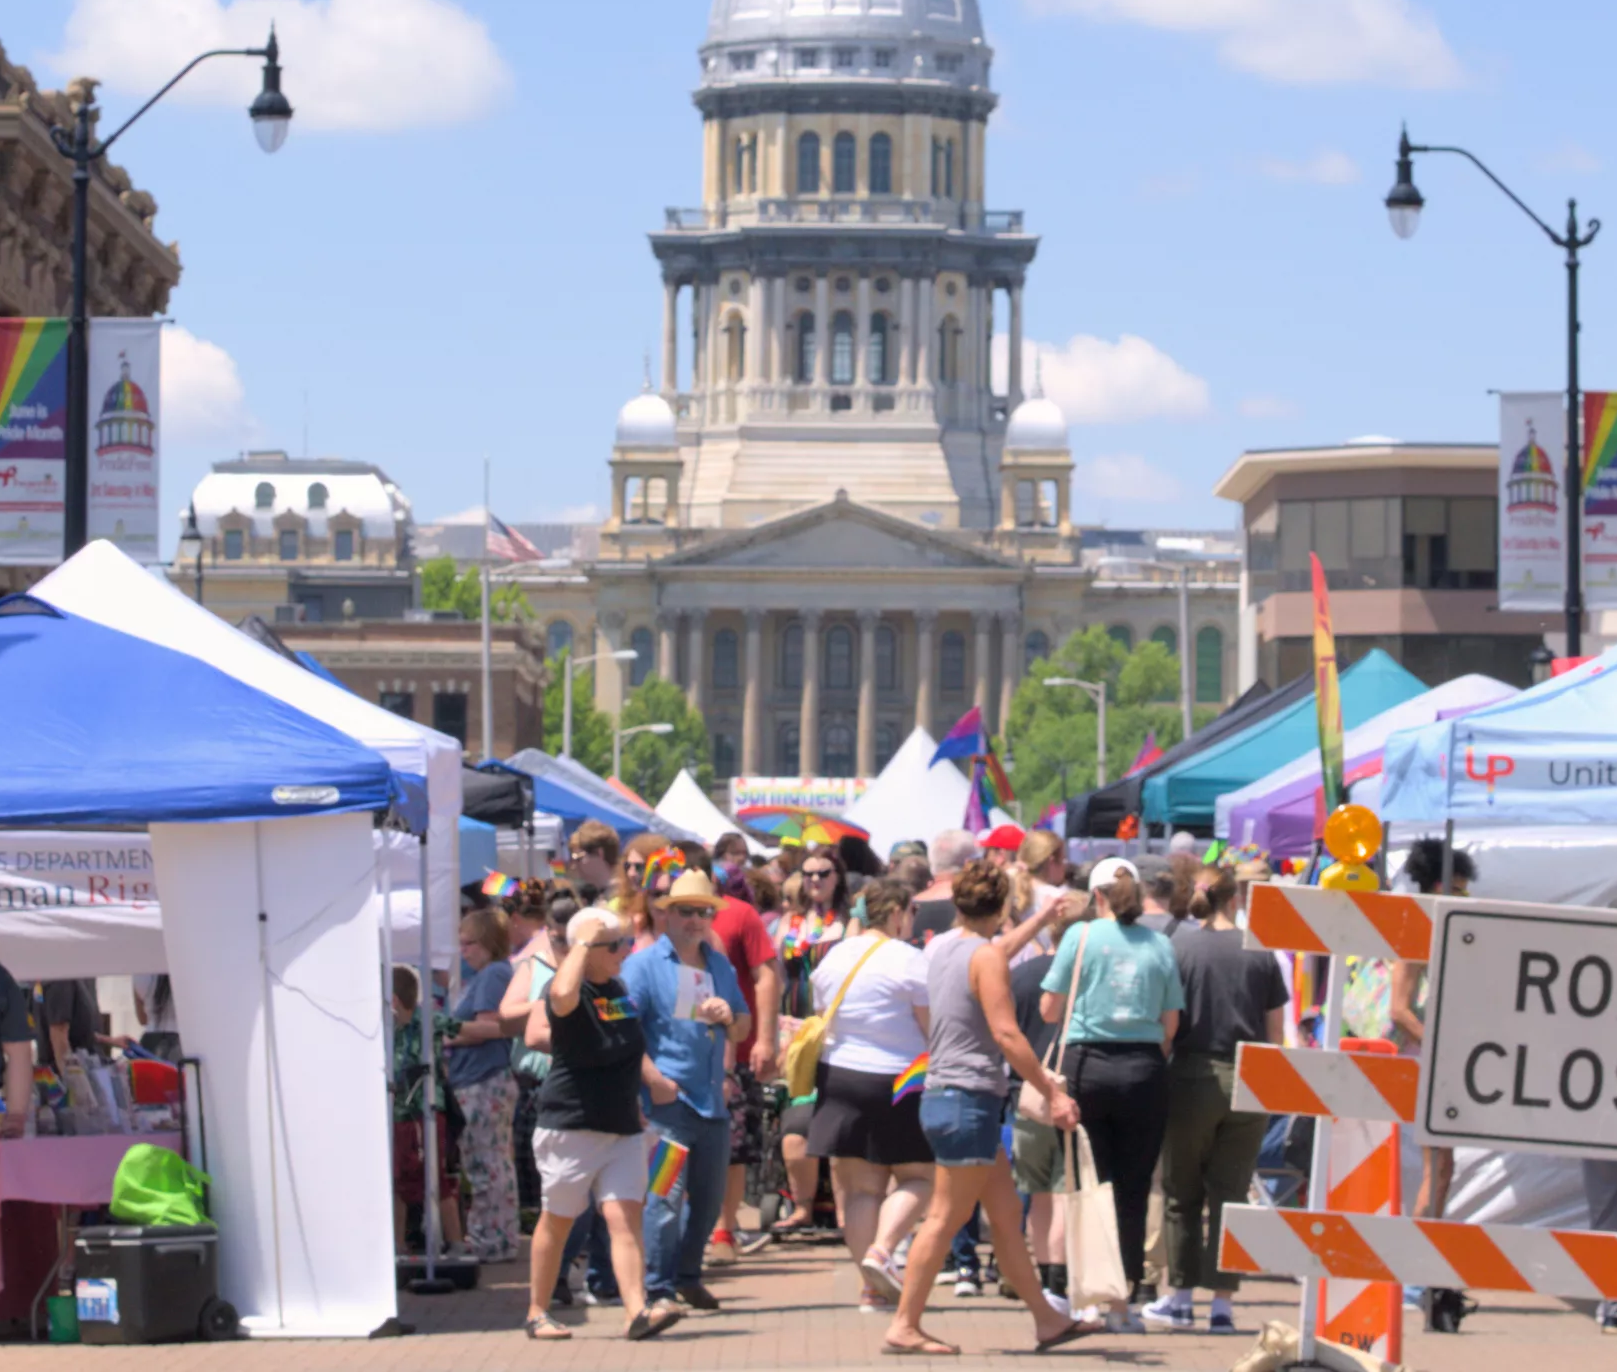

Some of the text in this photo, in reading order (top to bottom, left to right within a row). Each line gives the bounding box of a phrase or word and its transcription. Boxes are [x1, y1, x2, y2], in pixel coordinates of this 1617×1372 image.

[9, 402, 35, 419] June
[26, 425, 64, 441] Month
[16, 848, 154, 872] DEPARTMEN
[87, 874, 152, 910] Rig
